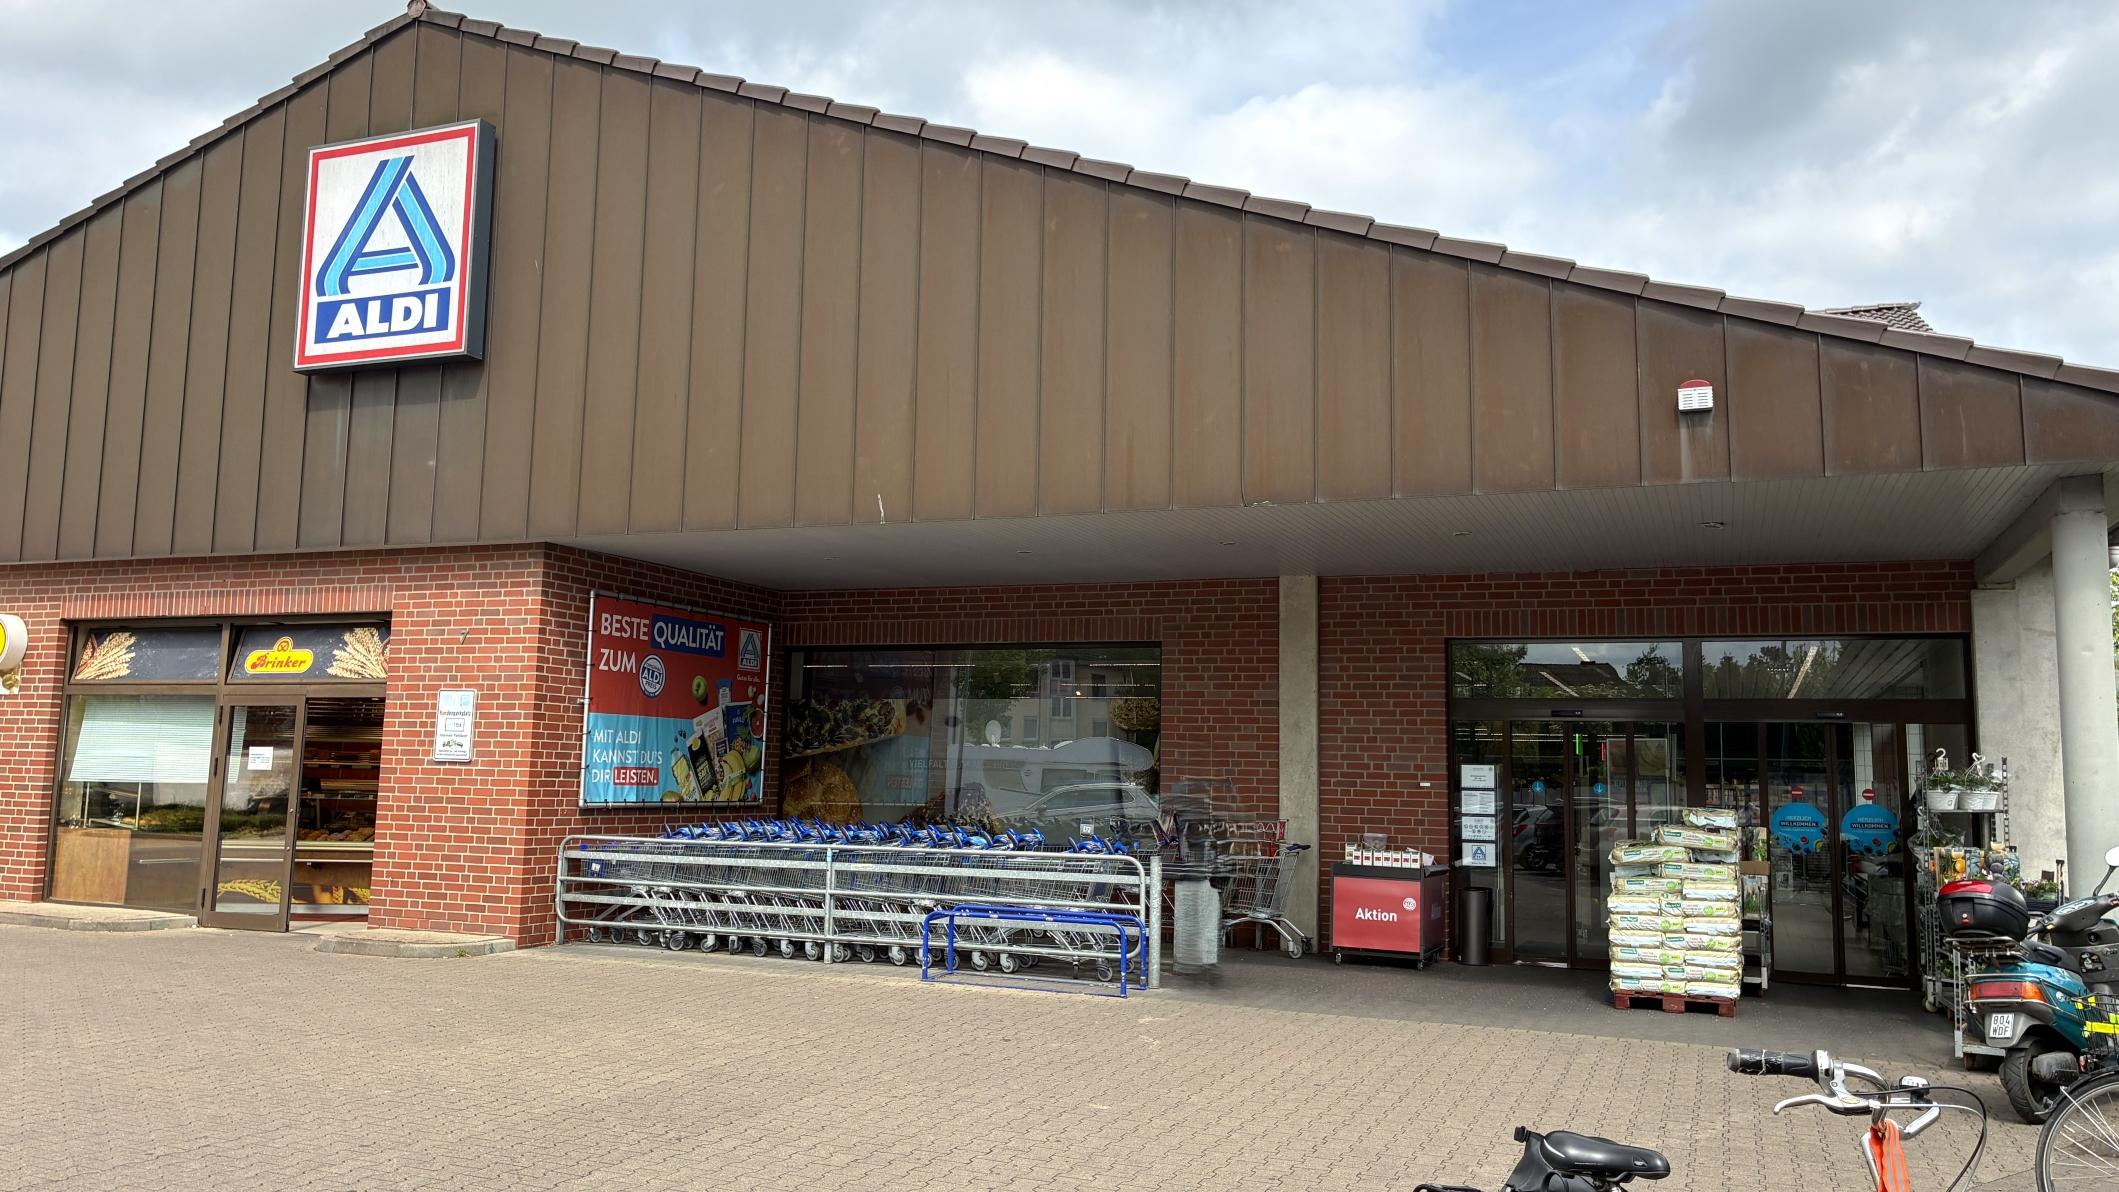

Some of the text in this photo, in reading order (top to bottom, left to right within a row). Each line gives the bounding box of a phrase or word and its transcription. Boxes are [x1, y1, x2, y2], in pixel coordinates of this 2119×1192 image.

[326, 293, 439, 339] ALDI
[601, 612, 724, 651] BESTE QUALITÄT
[250, 652, 306, 670] Brinker
[599, 648, 636, 674] ZUM
[742, 658, 758, 667] ALDI
[642, 667, 663, 685] ALDI
[645, 680, 658, 690] PREIS
[593, 729, 641, 744] MIT ALDI
[592, 749, 663, 764] KANNST DU'S
[909, 759, 948, 769] VIELFALT
[592, 769, 657, 784] DIR LEISTEN.
[1355, 907, 1398, 922] Aktion
[1993, 1015, 2010, 1025] 804
[1992, 1026, 2010, 1036] WDF
